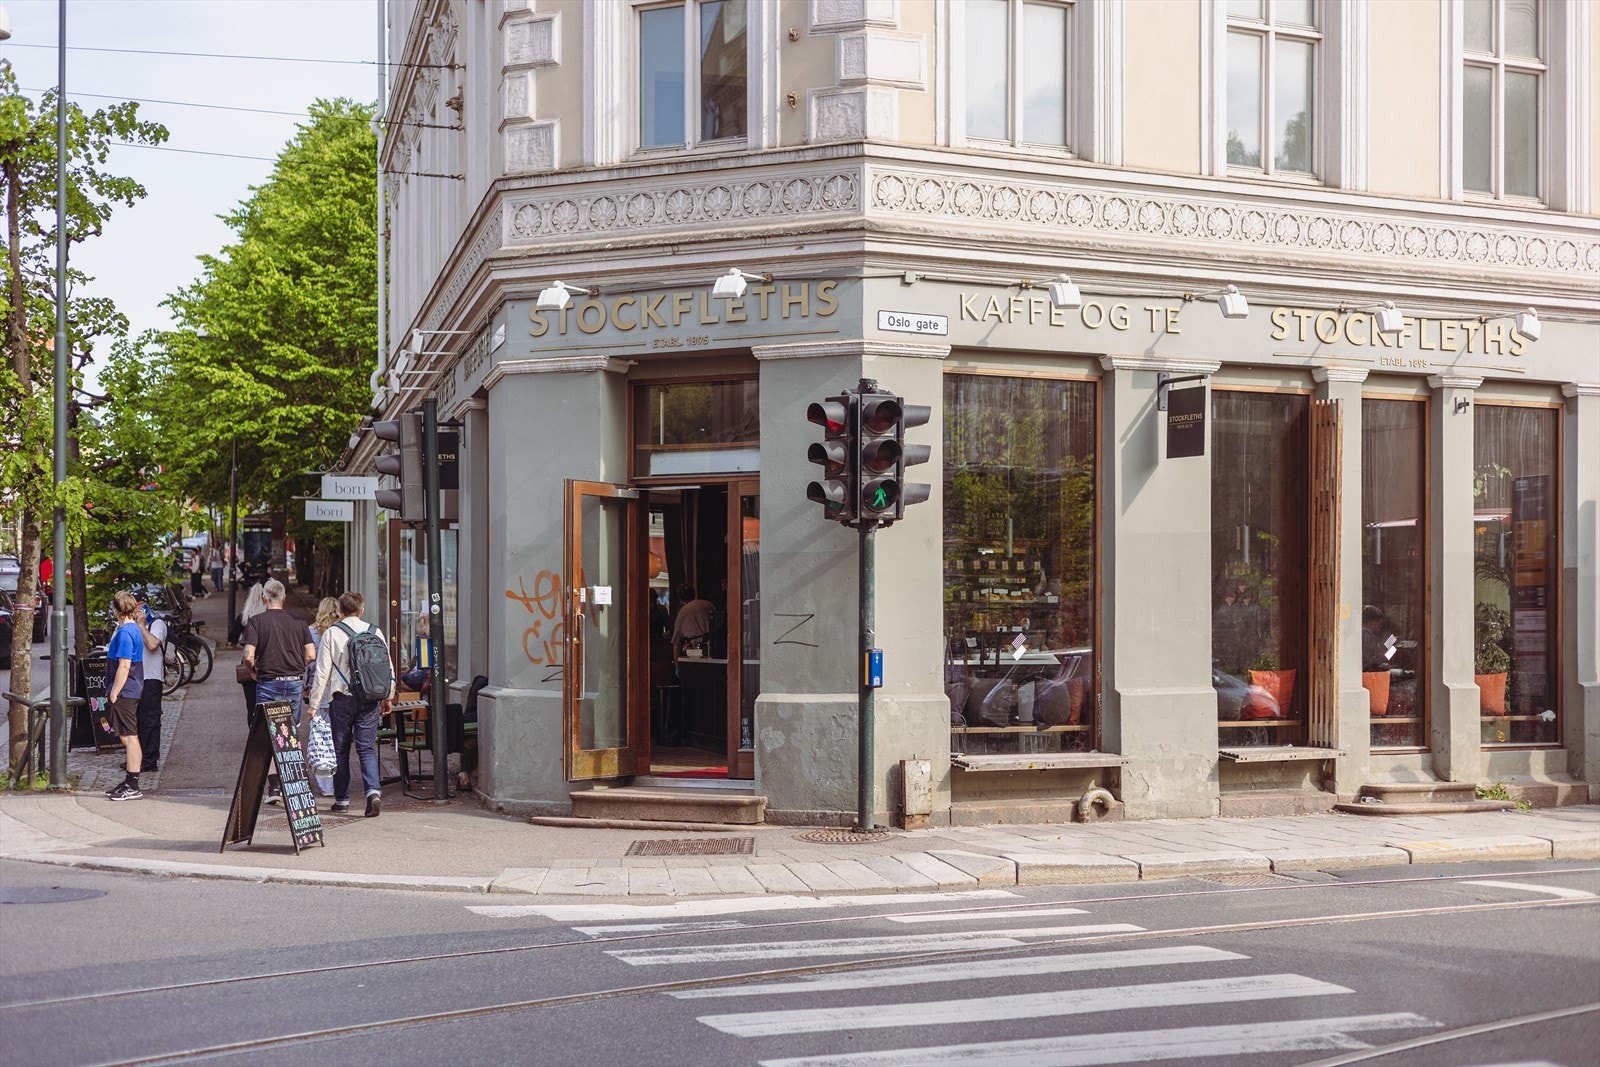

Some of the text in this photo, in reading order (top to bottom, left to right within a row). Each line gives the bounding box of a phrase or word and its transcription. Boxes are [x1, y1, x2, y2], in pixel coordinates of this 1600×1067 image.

[528, 279, 839, 337] STOCKFLETHS
[960, 292, 1182, 334] KAFFE OG TE
[888, 316, 939, 331] Oslo gate
[1270, 307, 1528, 357] STOCKFLETHS
[687, 335, 710, 346] 1895
[1408, 358, 1428, 369] 1895
[1169, 413, 1203, 423] STOCKFLETHS
